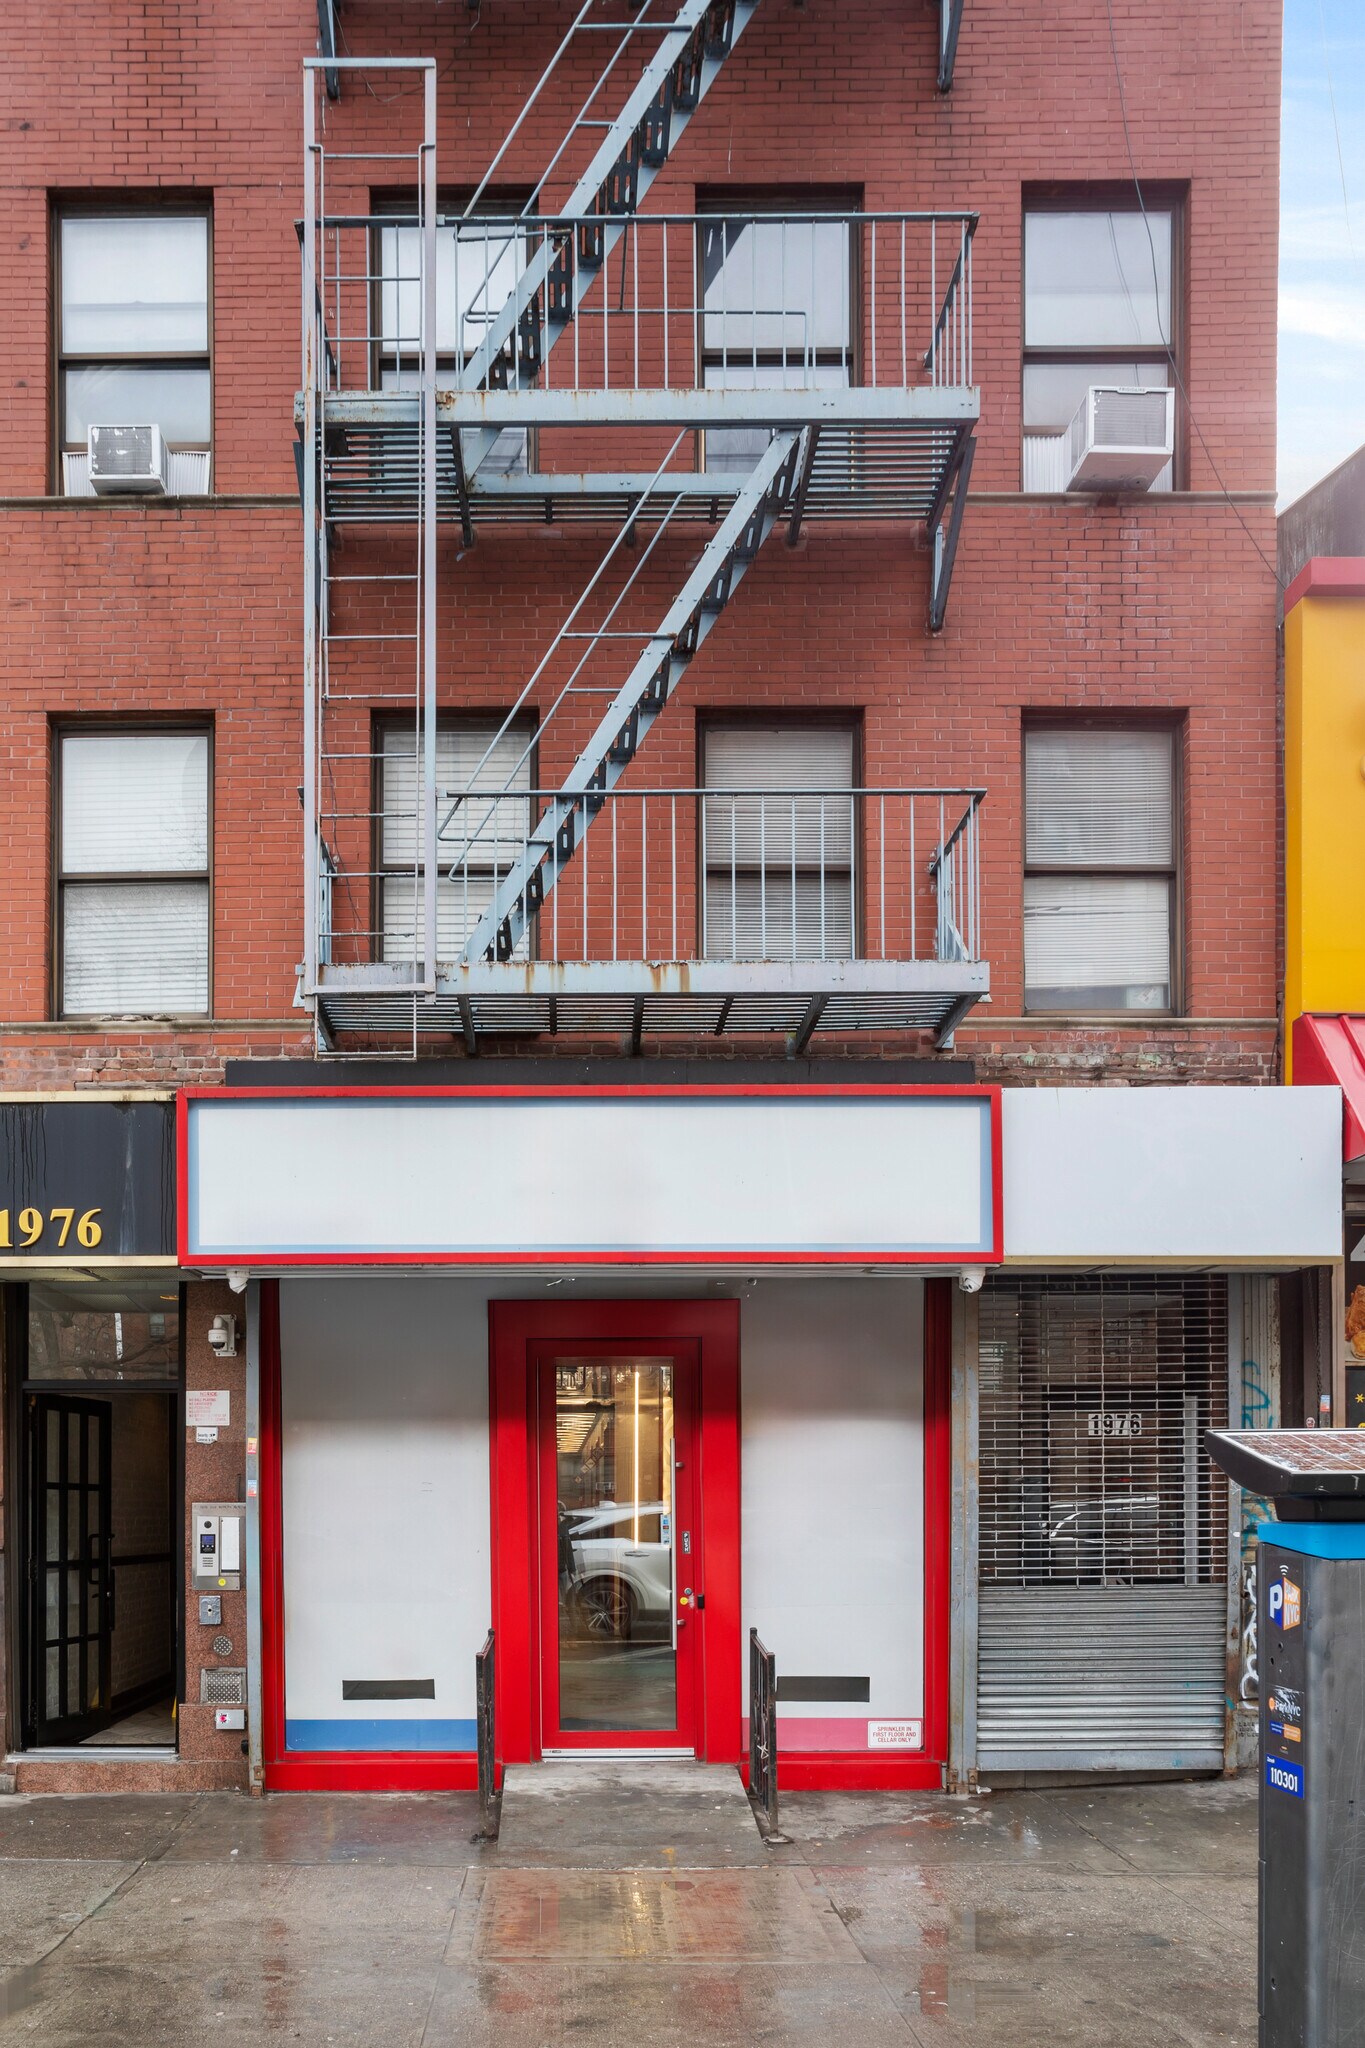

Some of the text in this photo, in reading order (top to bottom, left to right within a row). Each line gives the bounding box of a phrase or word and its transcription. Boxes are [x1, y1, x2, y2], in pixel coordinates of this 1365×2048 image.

[0, 1207, 102, 1247] 1976
[1091, 1414, 1140, 1434] 1976
[1270, 1584, 1283, 1619] P
[1284, 1604, 1300, 1625] NYC
[1270, 1767, 1298, 1792] 110301
